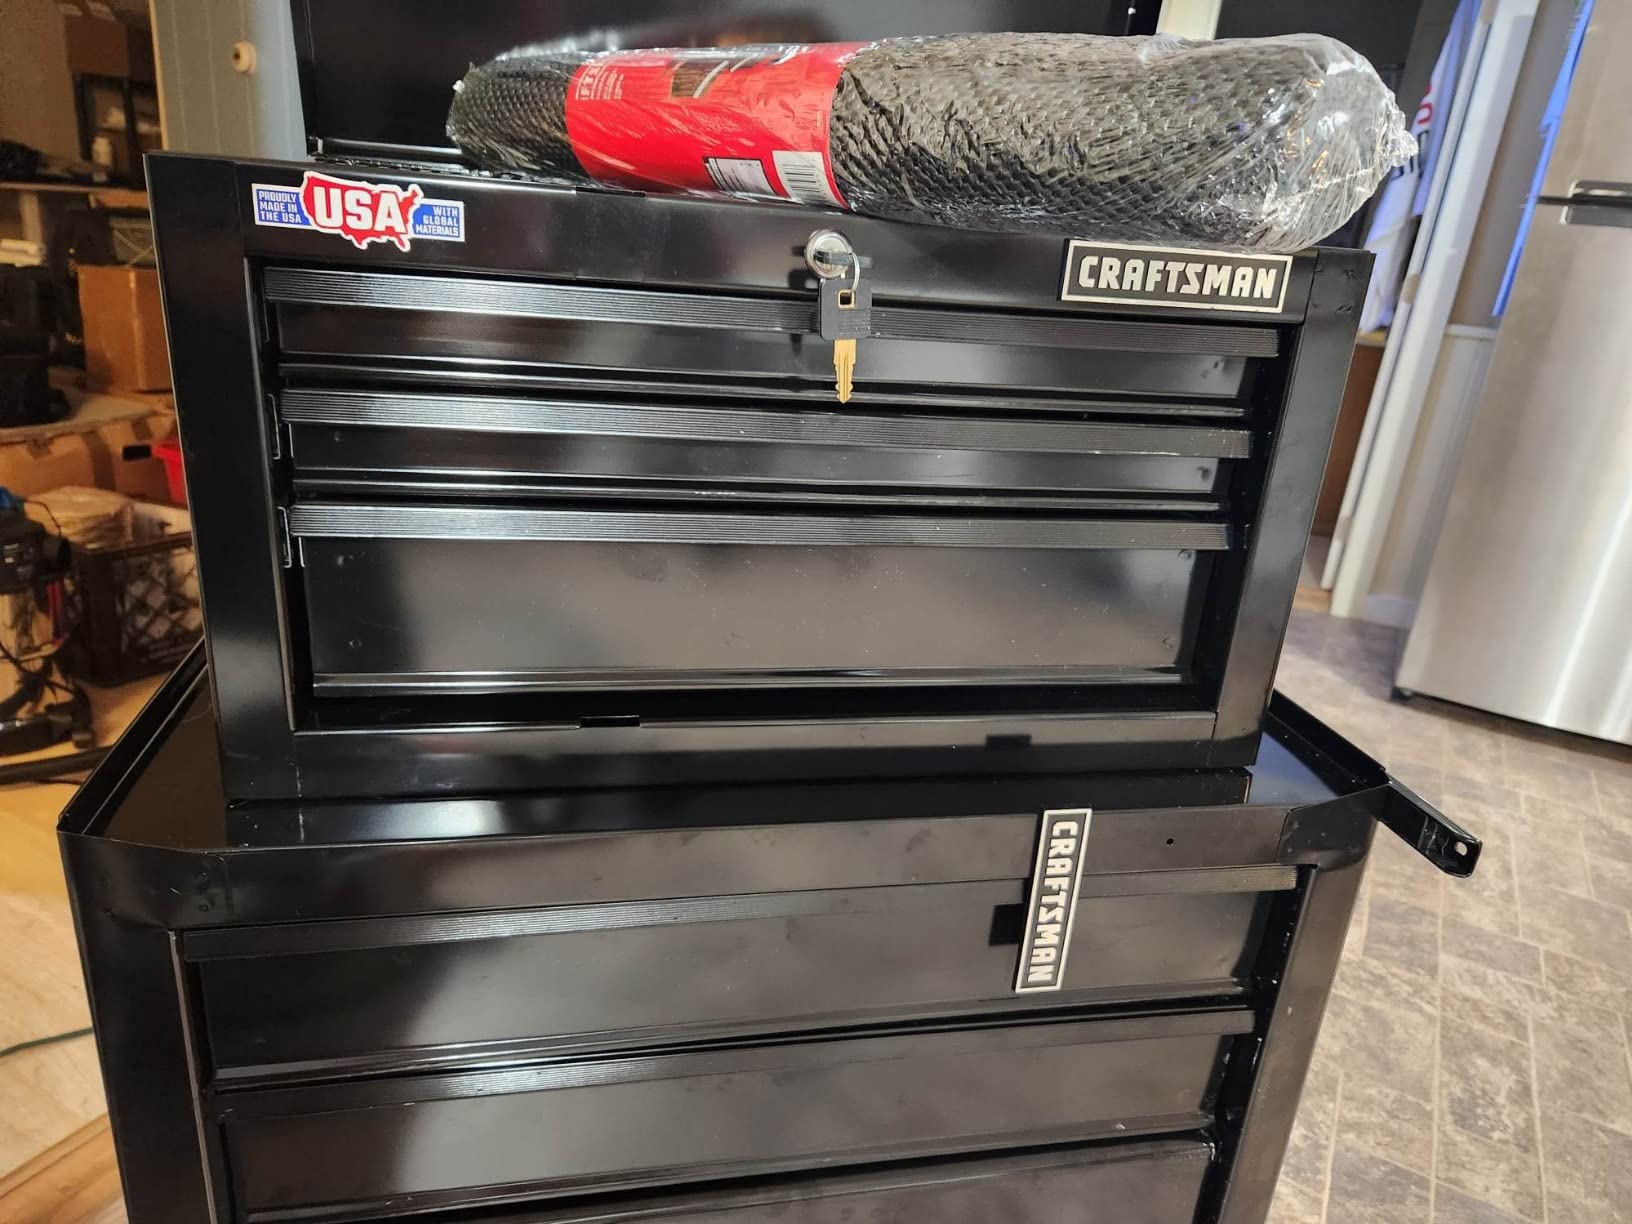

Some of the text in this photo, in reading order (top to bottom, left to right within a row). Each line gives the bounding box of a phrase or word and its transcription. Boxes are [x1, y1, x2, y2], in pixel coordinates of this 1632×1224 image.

[258, 190, 297, 203] PROUDLY
[260, 200, 298, 213] MADE IN
[313, 186, 406, 233] USA
[432, 205, 459, 217] WITH
[260, 210, 302, 224] THE USA
[422, 214, 459, 227] GLOBAL
[415, 223, 459, 237] MATERIALS
[1078, 255, 1278, 299] CRAFTSMAN
[1027, 820, 1079, 983] CRAFTSMAN
